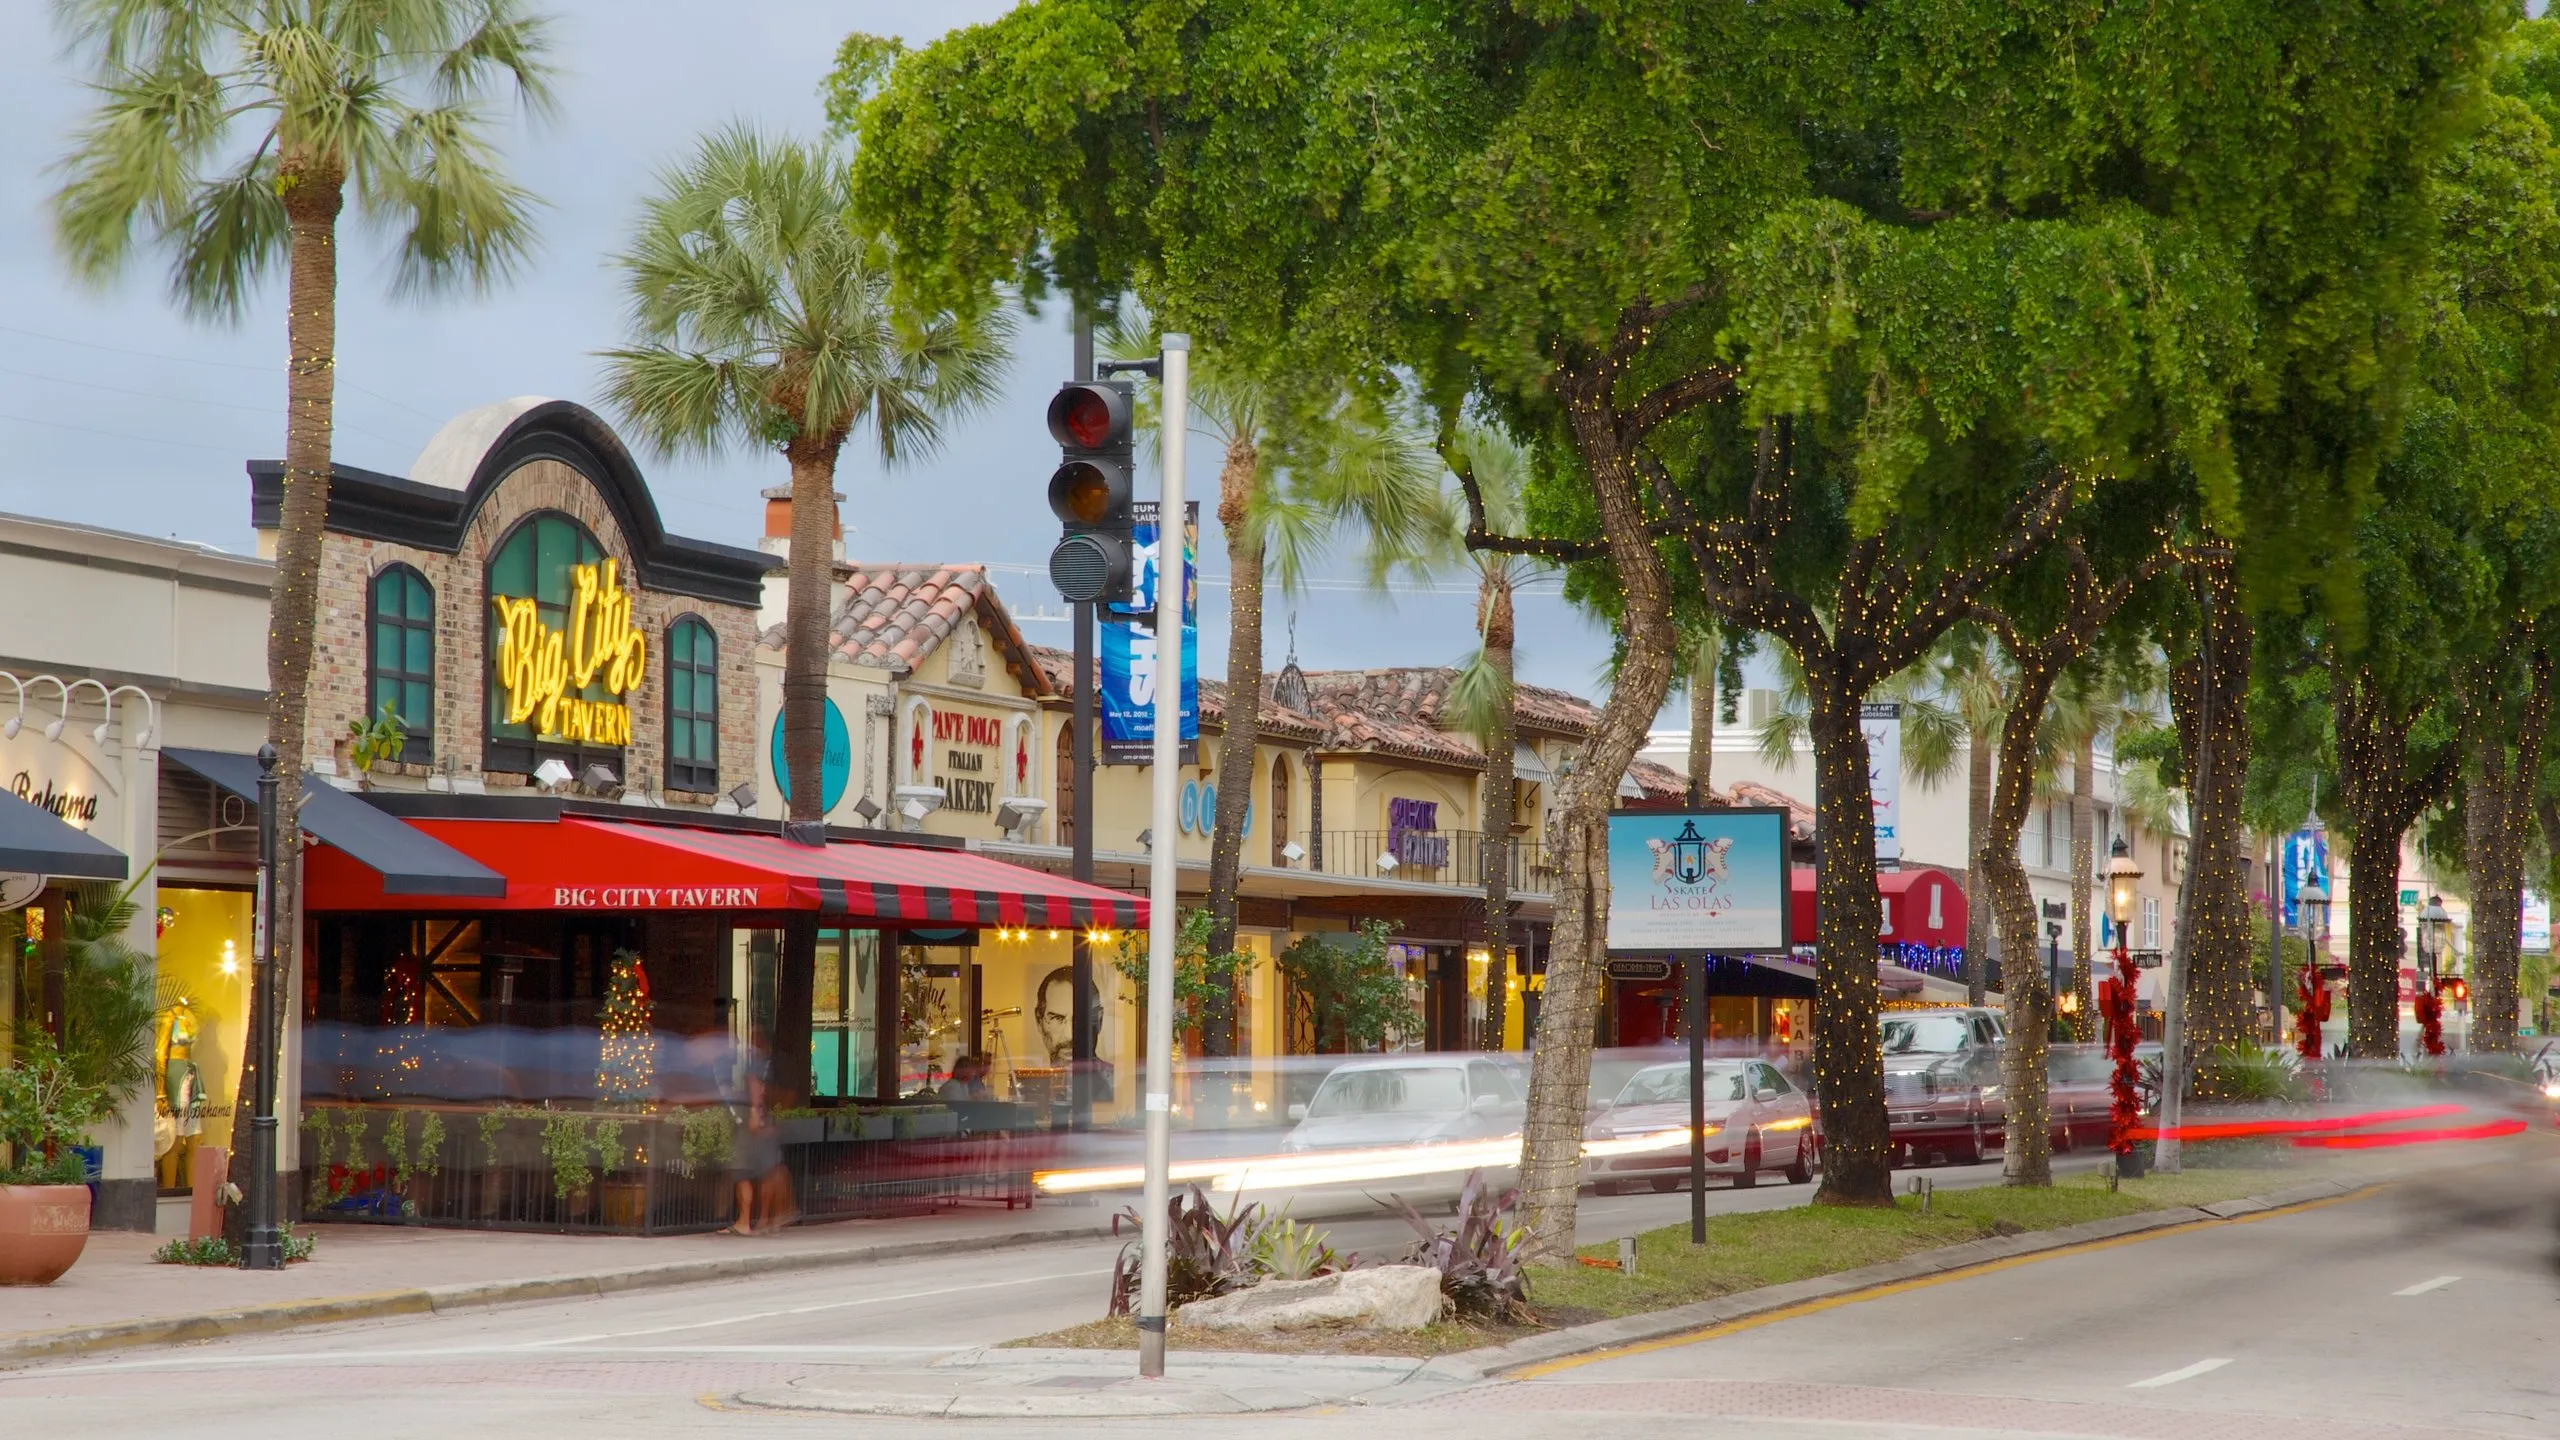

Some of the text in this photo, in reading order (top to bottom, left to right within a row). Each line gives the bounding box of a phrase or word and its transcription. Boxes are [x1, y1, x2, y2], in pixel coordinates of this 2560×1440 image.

[1133, 504, 1156, 513] EUM
[494, 557, 646, 735] Big City
[556, 698, 632, 746] TAVERN
[967, 715, 1001, 747] DOLCI
[948, 750, 982, 772] ITALIAN
[11, 770, 98, 821] Bahama
[935, 775, 996, 814] BAKERY
[554, 887, 759, 906] BIG CITY TAVERN
[1651, 893, 1732, 910] LAS OLAS
[1673, 886, 1708, 895] SKATE
